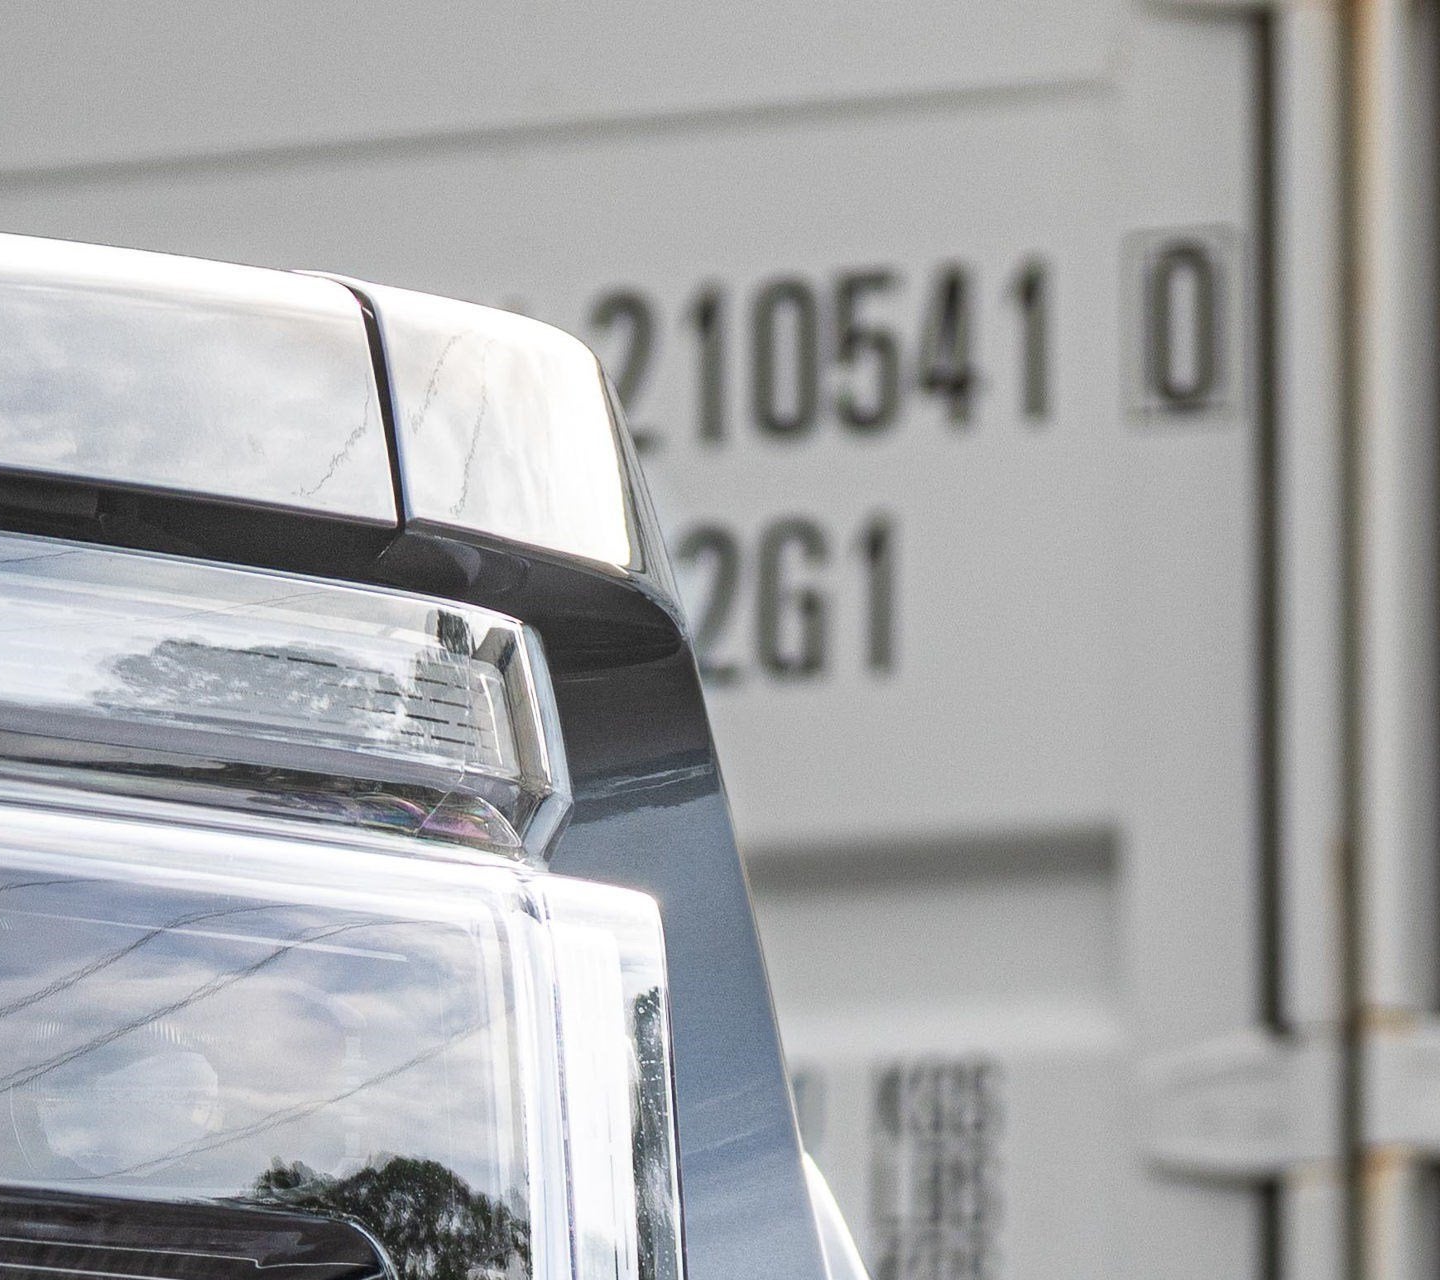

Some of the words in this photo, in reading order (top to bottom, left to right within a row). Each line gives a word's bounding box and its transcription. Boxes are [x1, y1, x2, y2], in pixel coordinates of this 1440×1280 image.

[590, 258, 1056, 455] 210541
[1144, 236, 1220, 416] 0
[676, 512, 900, 688] 2G1
